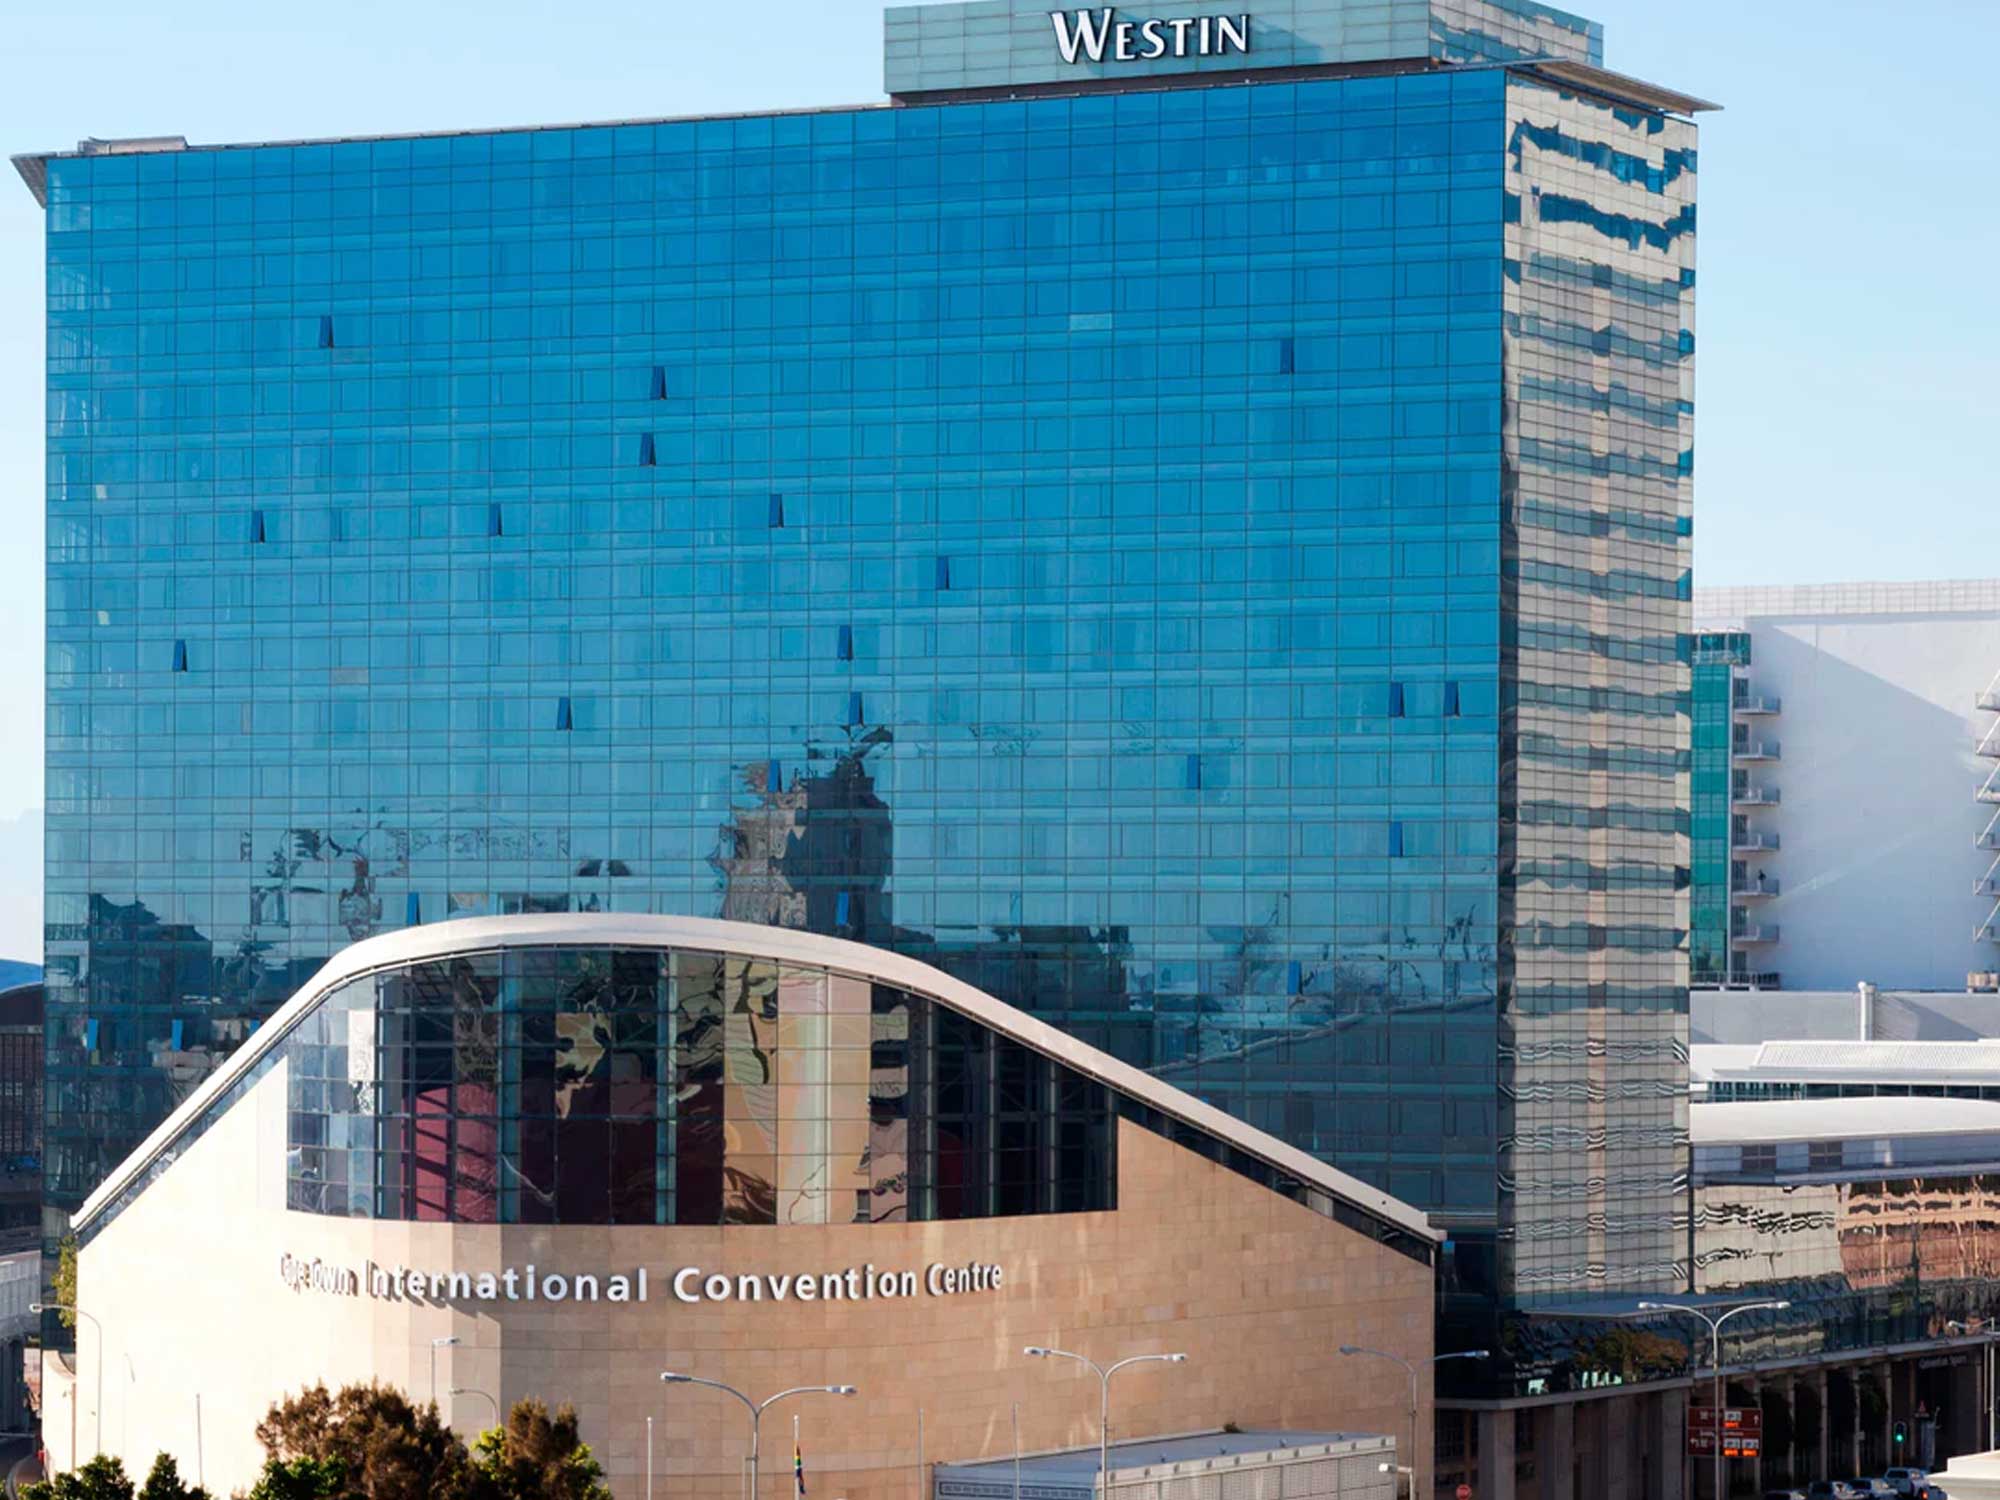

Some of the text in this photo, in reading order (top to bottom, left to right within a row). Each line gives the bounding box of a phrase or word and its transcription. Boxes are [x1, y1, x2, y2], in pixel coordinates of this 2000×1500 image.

[1051, 8, 1249, 64] WESTIN
[363, 1258, 648, 1302] International
[673, 1264, 917, 1302] Convention
[926, 1261, 1003, 1297] Centre
